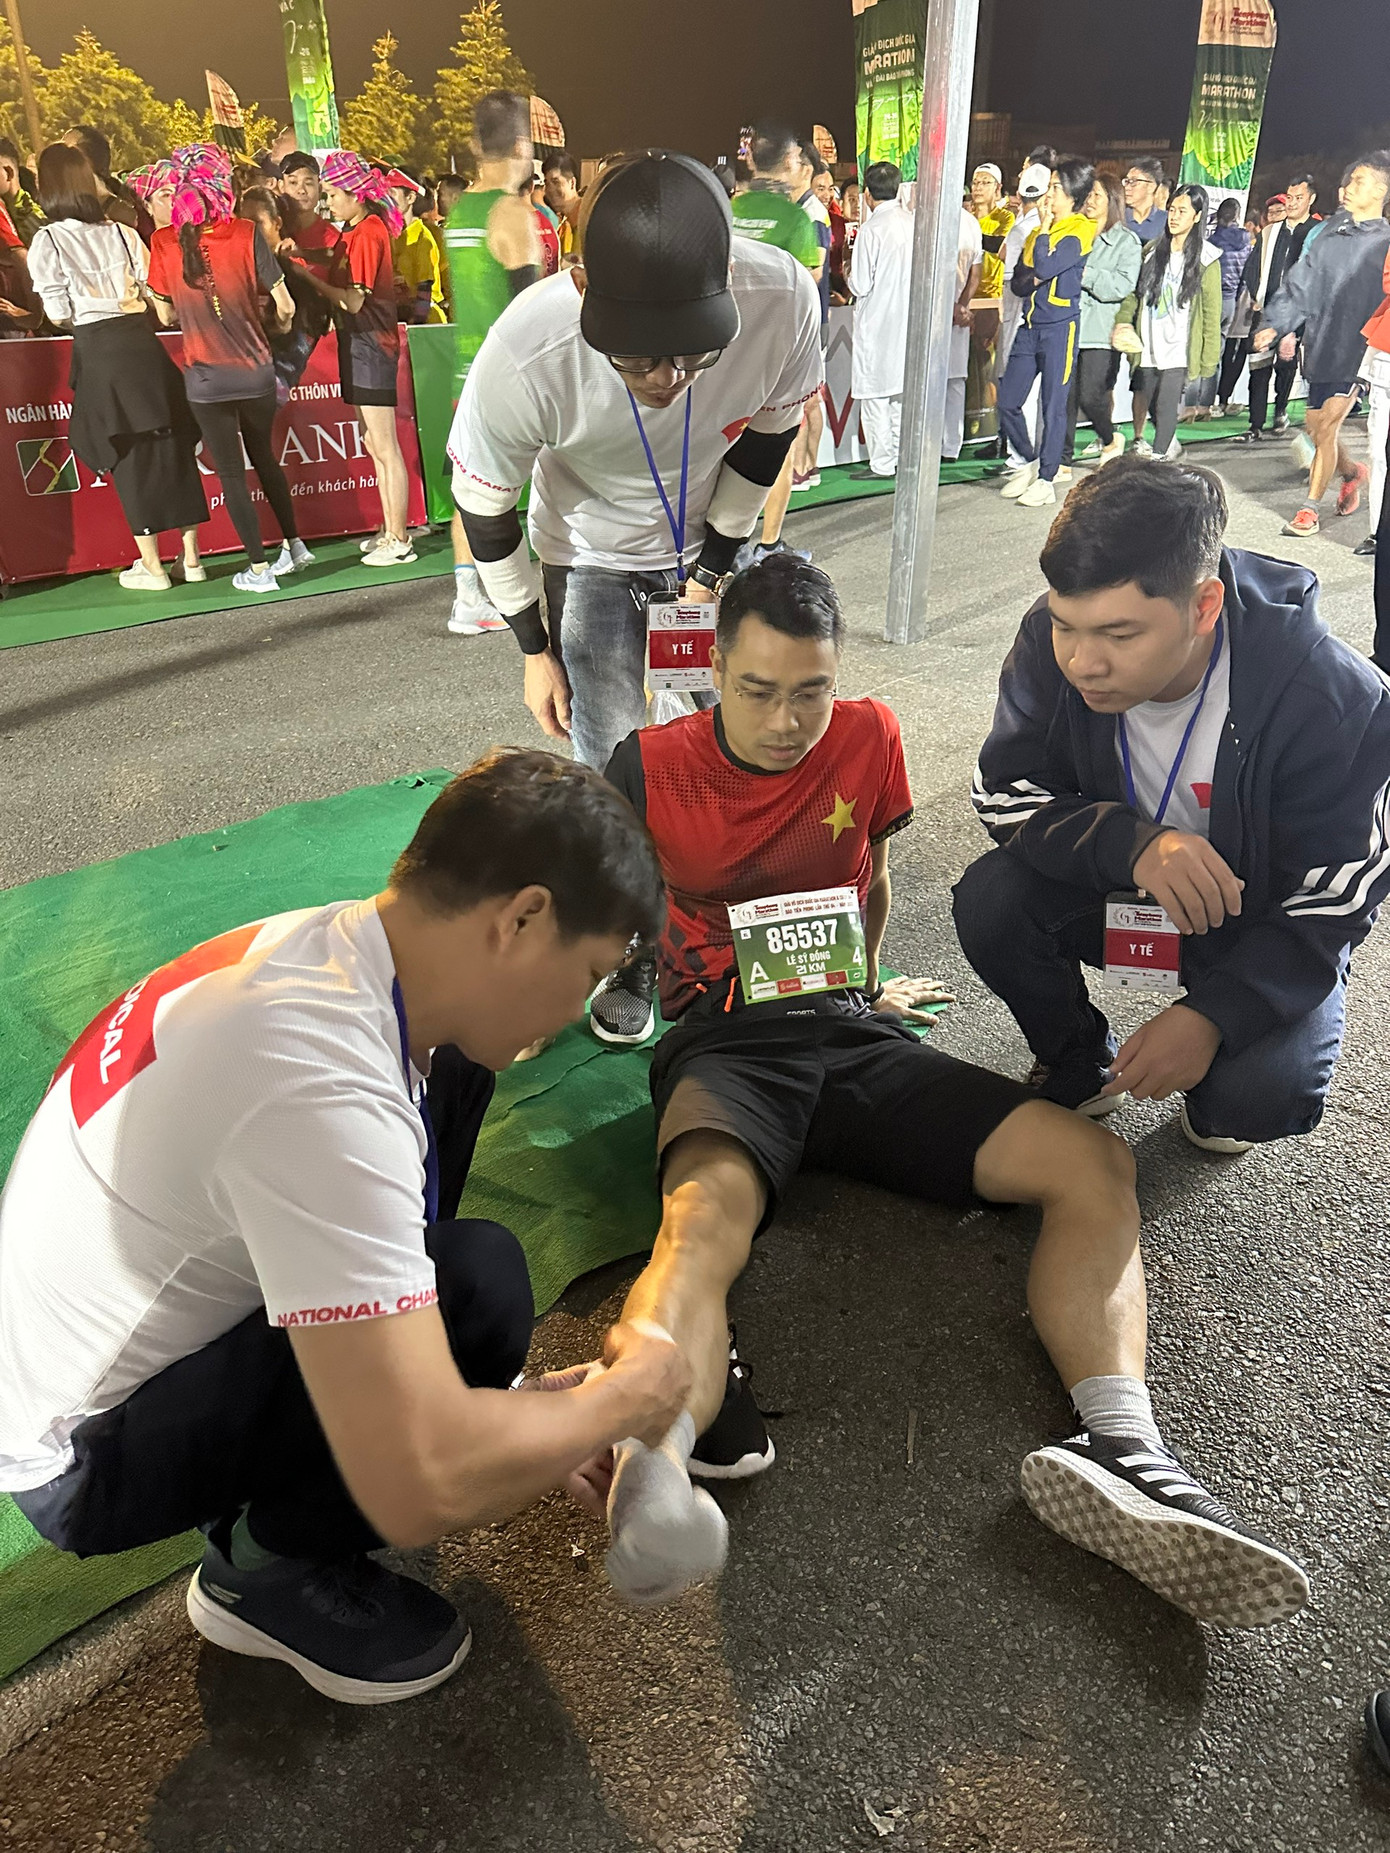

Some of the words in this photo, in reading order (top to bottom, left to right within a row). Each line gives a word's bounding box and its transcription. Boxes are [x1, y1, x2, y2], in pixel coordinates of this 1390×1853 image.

[864, 48, 916, 76] MRATHON
[1201, 84, 1257, 100] MARATHON
[5, 403, 48, 424] NGÂN
[298, 382, 331, 400] THÔN
[289, 482, 314, 497] đến
[317, 475, 356, 492] khách
[671, 644, 679, 655] Y
[681, 640, 694, 655] TẾ
[766, 919, 838, 954] 85537
[852, 946, 863, 966] 4
[1129, 944, 1137, 955] Y
[1139, 942, 1154, 956] TẾ
[750, 961, 770, 983] A
[796, 965, 807, 975] 21
[809, 962, 826, 973] KM
[277, 1301, 388, 1328] NATIONAL
